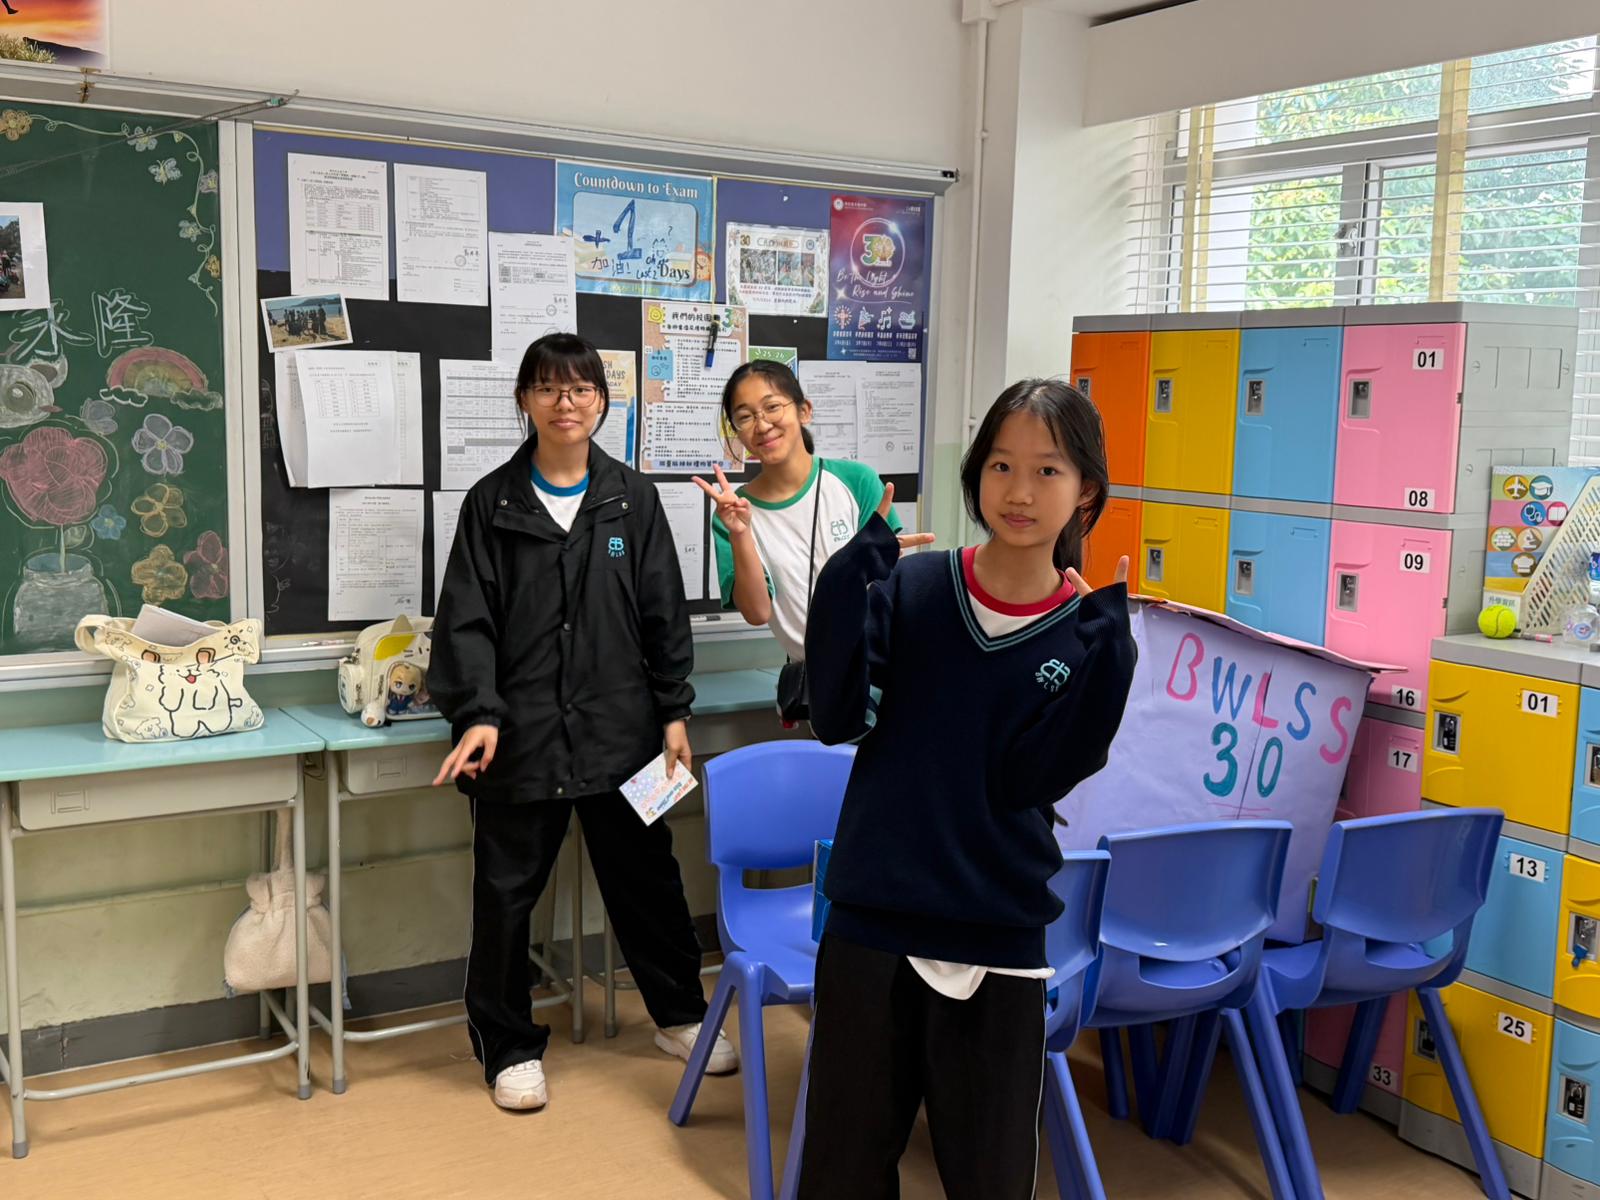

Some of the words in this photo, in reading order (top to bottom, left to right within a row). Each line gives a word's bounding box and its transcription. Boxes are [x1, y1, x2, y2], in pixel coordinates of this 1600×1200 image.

[574, 172, 644, 193] Countdown
[648, 183, 660, 195] to
[663, 182, 698, 199] Exam
[656, 264, 690, 282] Days
[1418, 351, 1436, 367] 01
[1408, 491, 1428, 507] 08
[1404, 554, 1424, 570] 09
[1166, 632, 1352, 764] BWLSS
[1396, 689, 1415, 707] 16
[1527, 694, 1548, 712] 01
[1203, 722, 1283, 798] 30
[1392, 751, 1411, 768] 17
[1516, 858, 1537, 877] 13
[1503, 1016, 1525, 1038] 25
[1373, 1066, 1391, 1085] 33
